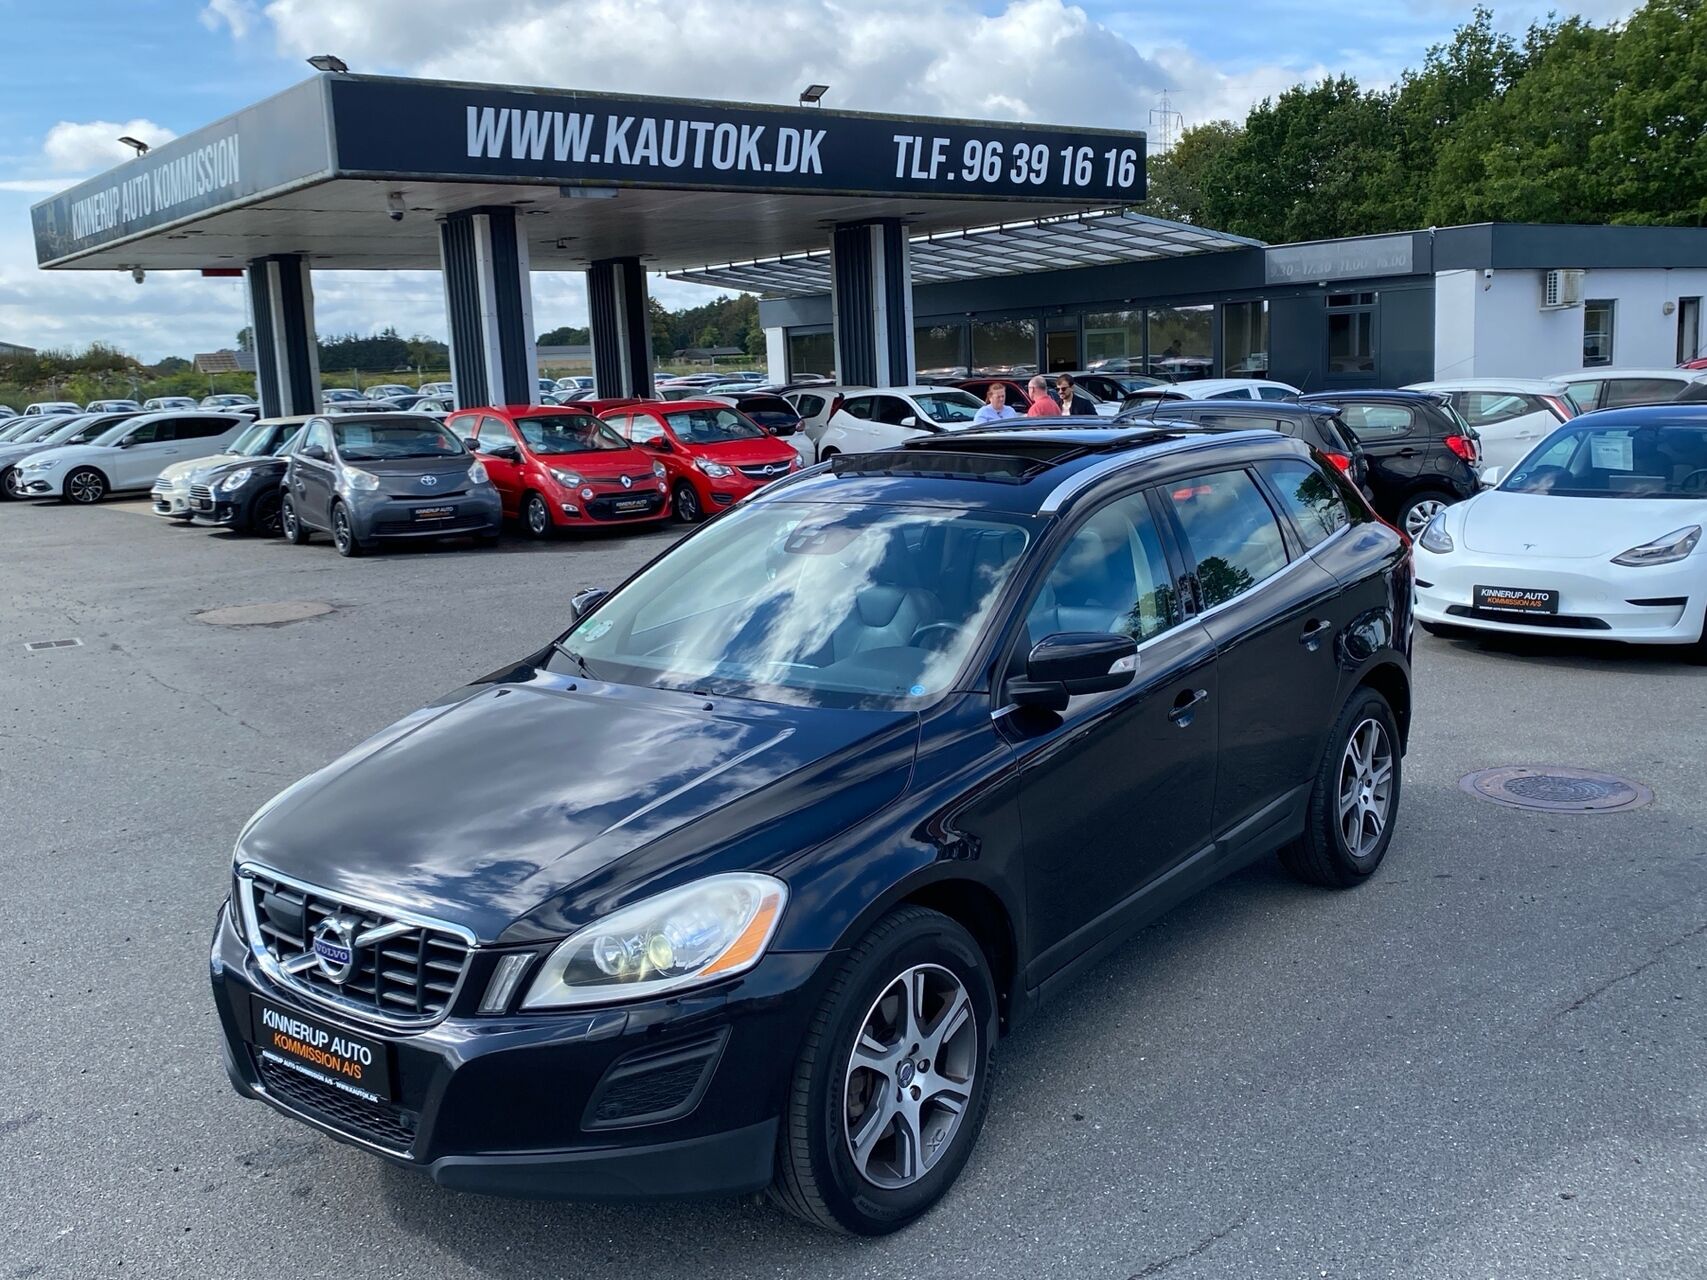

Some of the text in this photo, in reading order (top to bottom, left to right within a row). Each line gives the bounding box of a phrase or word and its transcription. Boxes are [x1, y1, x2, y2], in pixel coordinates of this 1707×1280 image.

[466, 105, 828, 175] WWW.KAUTOK.DK
[893, 134, 1137, 188] TLF. 96 39 16 16
[71, 133, 240, 241] KINNERUP AUTO KOMMISSION
[1481, 588, 1550, 601] KINNERUP AUTO
[1487, 597, 1530, 606] KOMMISSION
[315, 942, 348, 961] VOLVO
[263, 1008, 372, 1066] KINNERUP AUTO
[274, 1032, 362, 1079] KOMMISSION A/S
